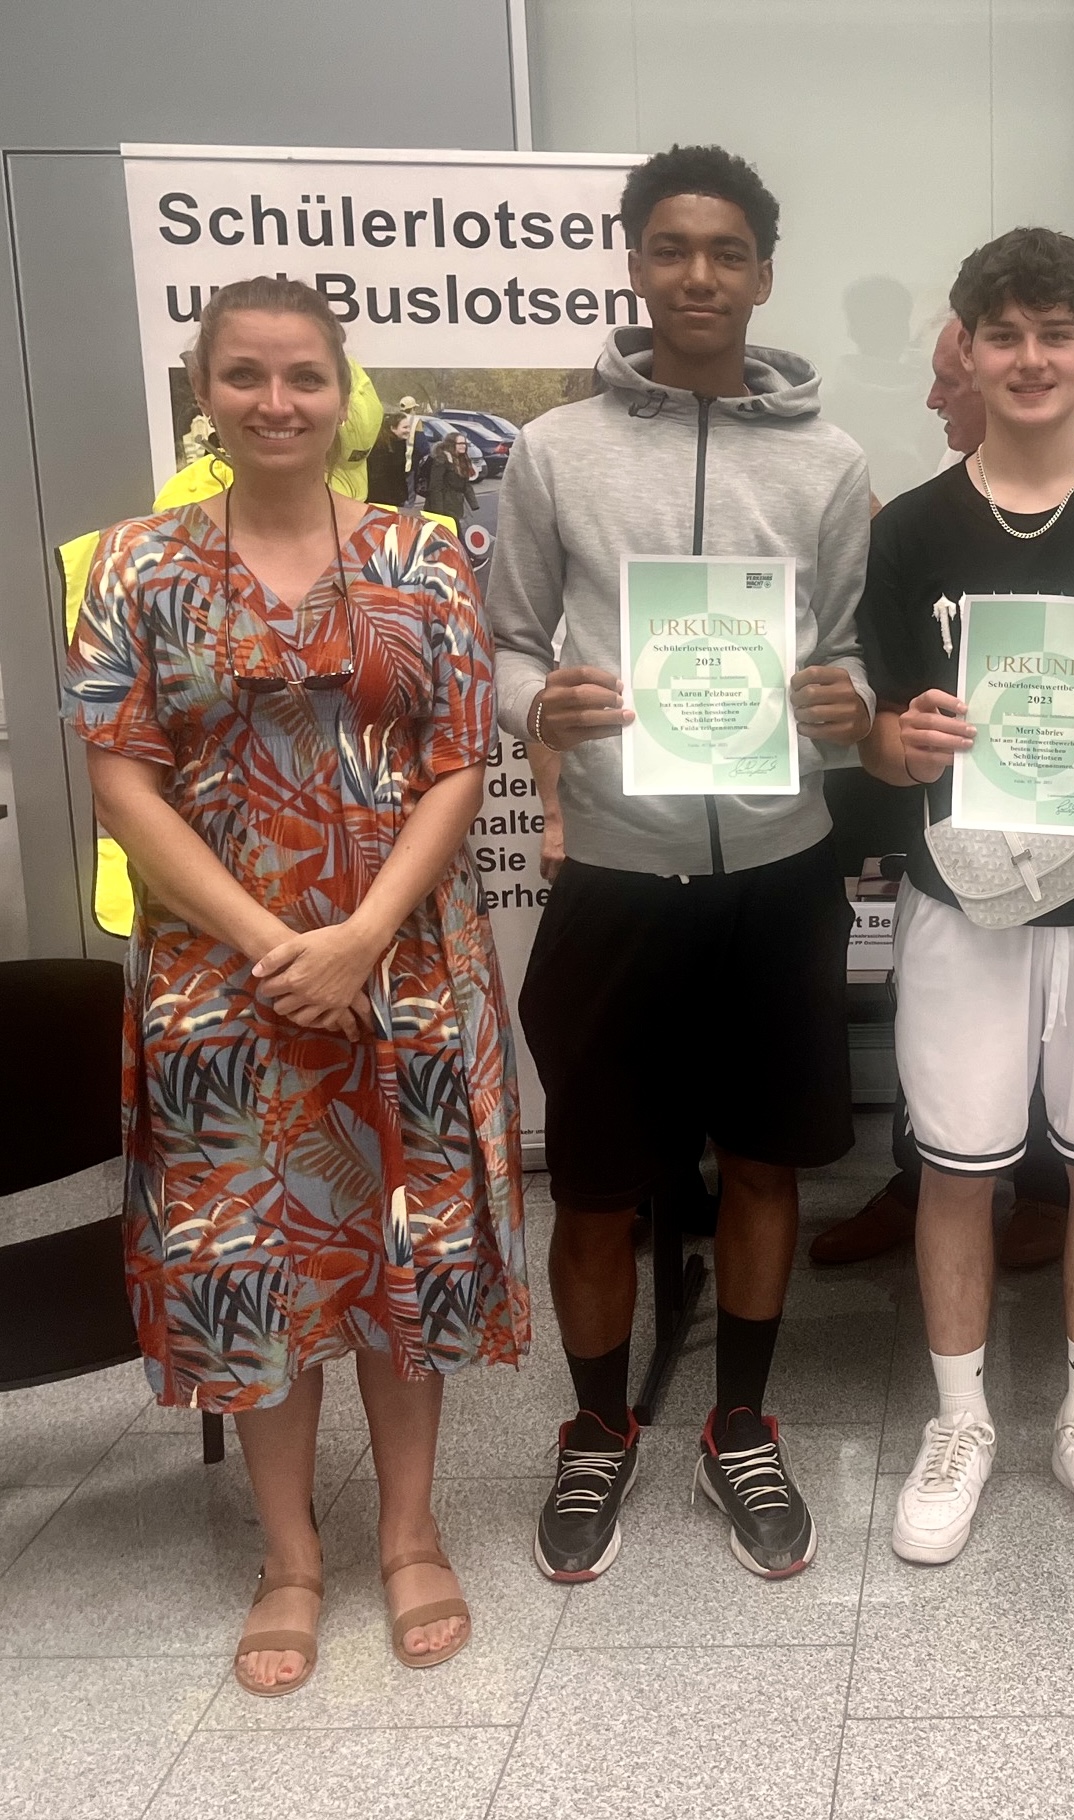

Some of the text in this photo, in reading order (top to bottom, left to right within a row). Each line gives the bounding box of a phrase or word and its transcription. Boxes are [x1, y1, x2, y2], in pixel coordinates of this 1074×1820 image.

[158, 192, 631, 250] Schülerlotsen
[316, 274, 638, 326] Buslotsen
[648, 619, 768, 636] URKUNDE
[653, 644, 764, 652] Schülerlotsenwettbewerb
[695, 657, 722, 666] 2023
[678, 690, 702, 698] Aaron
[1027, 695, 1053, 705] 2023
[1015, 727, 1034, 735] Mert
[476, 847, 526, 872] Sie
